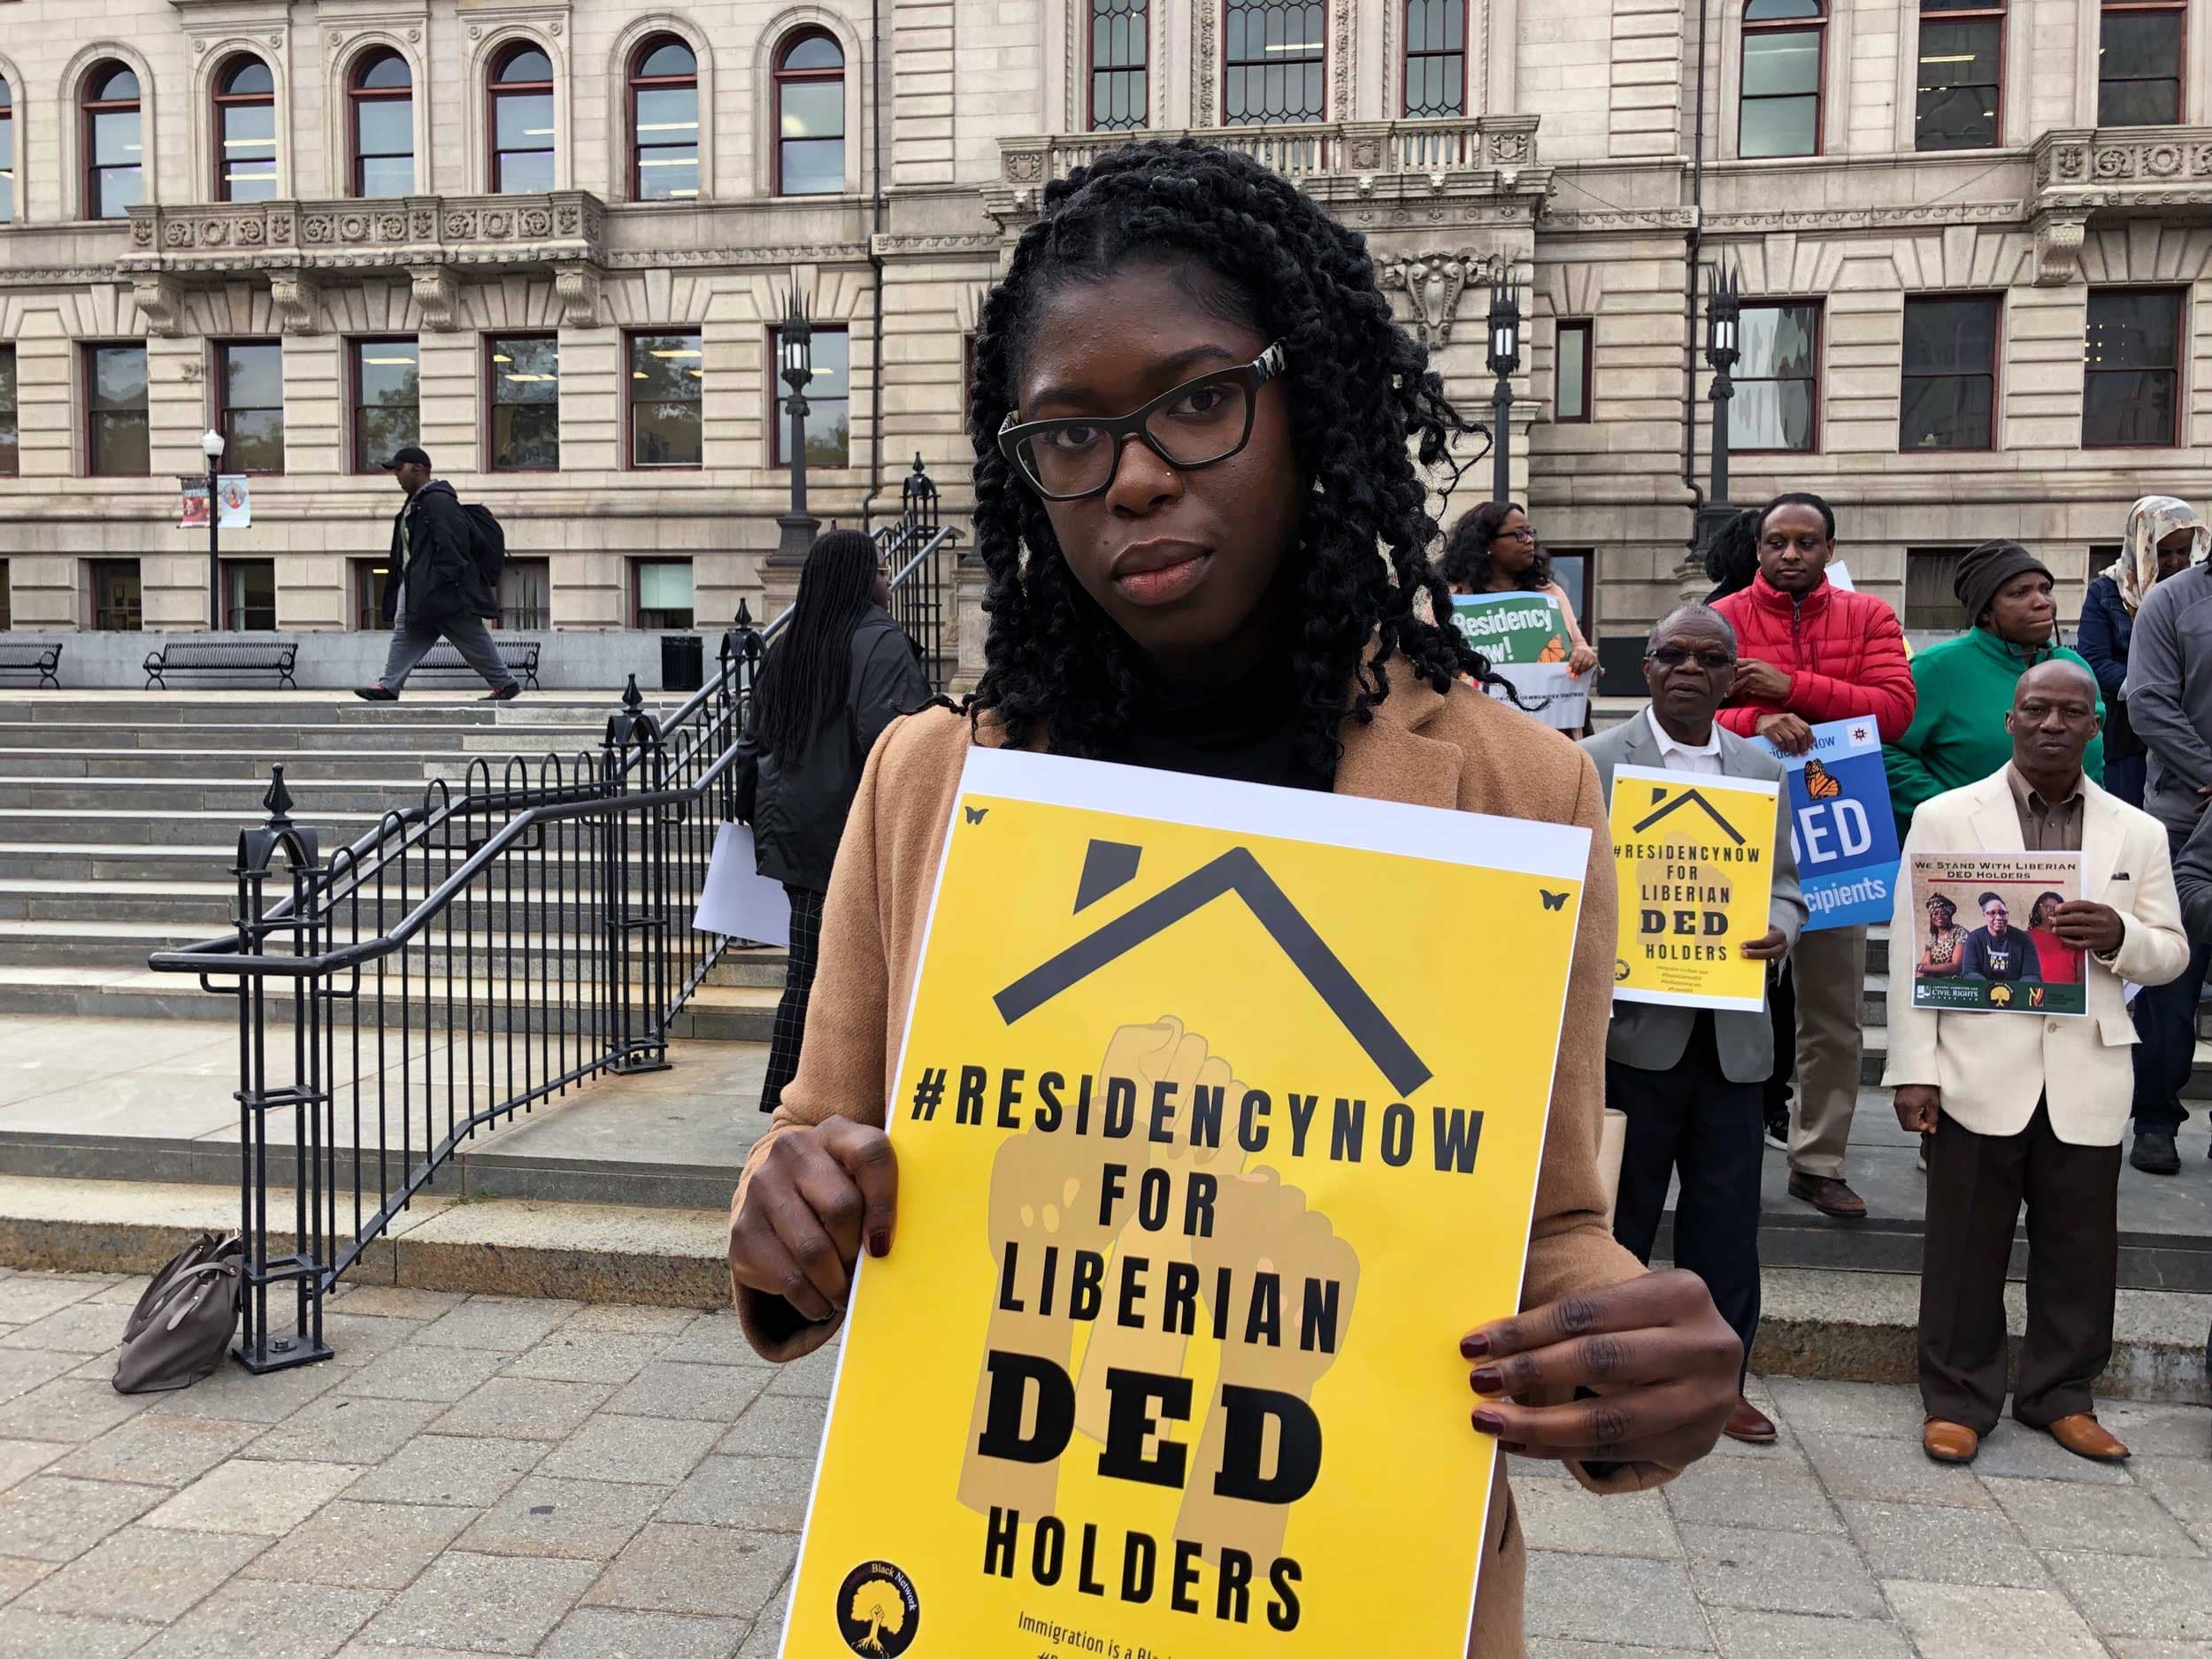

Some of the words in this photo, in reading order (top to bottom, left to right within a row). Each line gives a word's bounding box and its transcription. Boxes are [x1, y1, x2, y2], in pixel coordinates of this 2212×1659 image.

[1449, 607, 1552, 636] Residency
[1471, 636, 1514, 664] ow!
[1790, 798, 1871, 864] ED
[1614, 844, 1760, 863] #RESIDENCYNOW
[1667, 864, 1698, 880] FOR
[1642, 885, 1730, 902] LIBERIAN
[1806, 877, 1887, 913] cipients
[1640, 909, 1728, 935] DED
[1646, 943, 1727, 961] HOLDERS
[910, 1064, 1485, 1175] #RESIDENCYNOW
[1097, 1163, 1219, 1238] FOR
[998, 1241, 1340, 1355] LIBERIAN
[977, 1349, 1323, 1505] DED
[872, 1563, 895, 1578] Black
[895, 1571, 918, 1612] Network
[983, 1506, 1302, 1632] HOLDERS
[1018, 1610, 1104, 1654] Immigration
[1108, 1639, 1120, 1659] is
